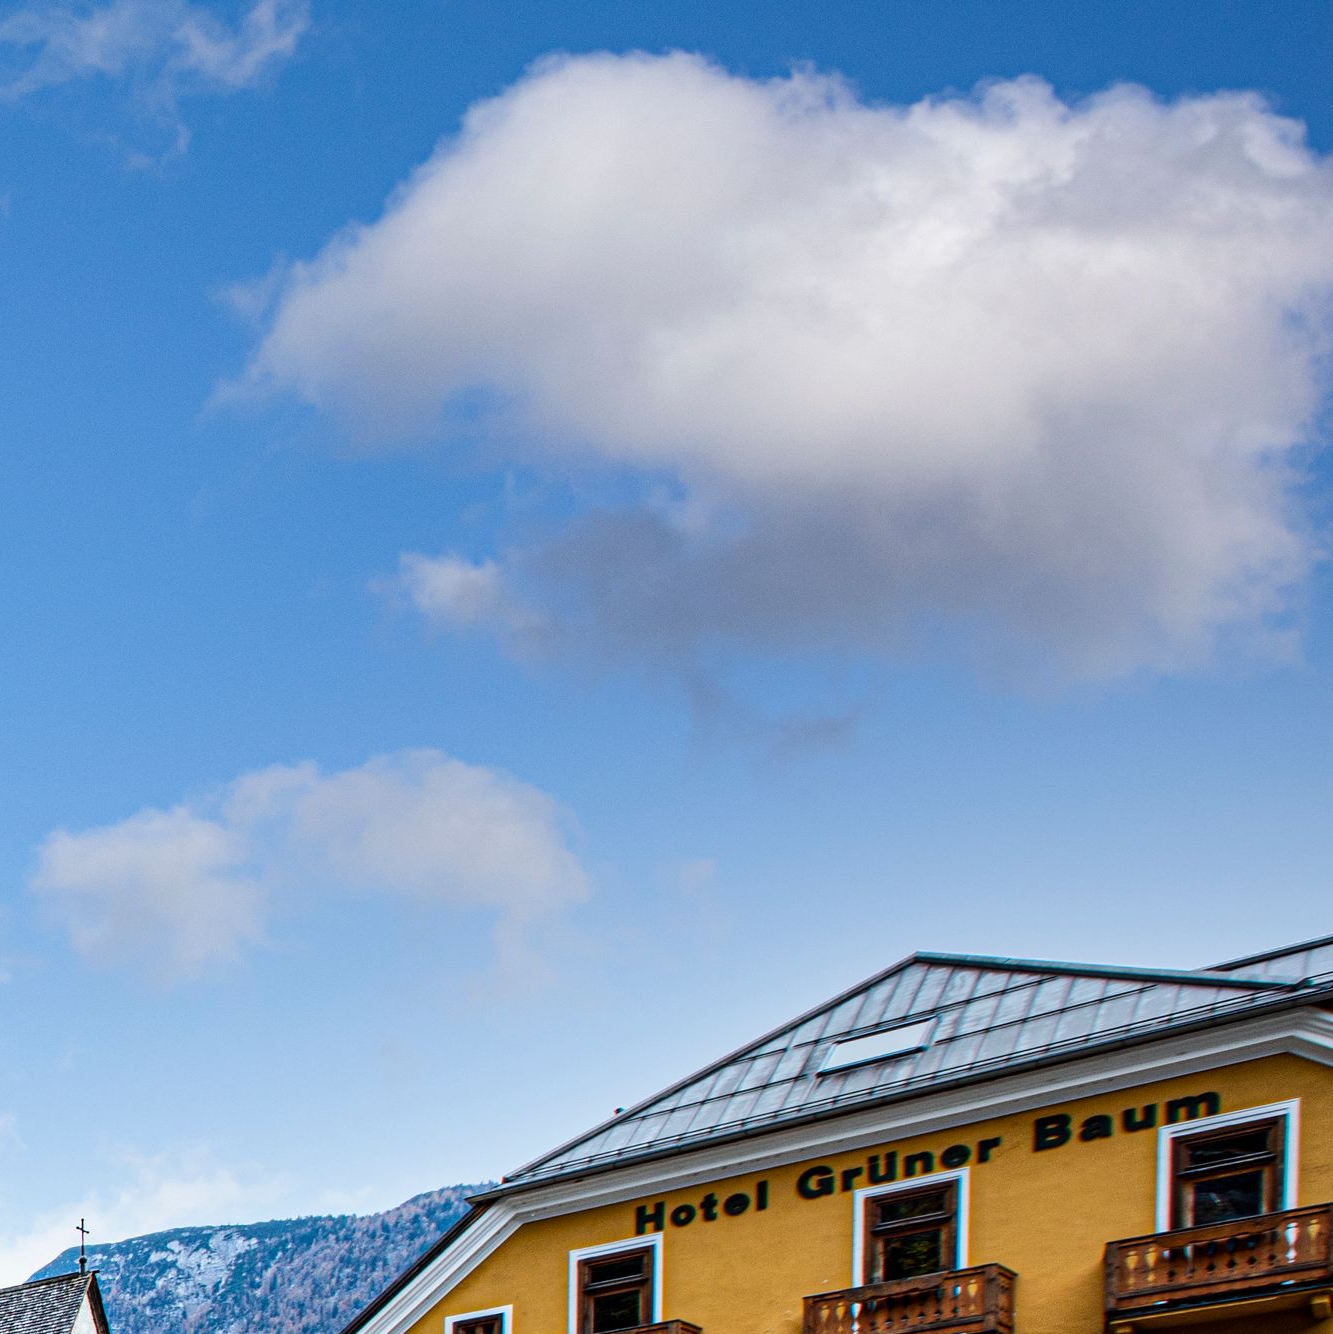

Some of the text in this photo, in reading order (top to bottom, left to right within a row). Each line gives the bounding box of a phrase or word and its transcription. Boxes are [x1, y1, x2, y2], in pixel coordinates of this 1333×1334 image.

[635, 1090, 1222, 1235] Hotel Grüner Baum
